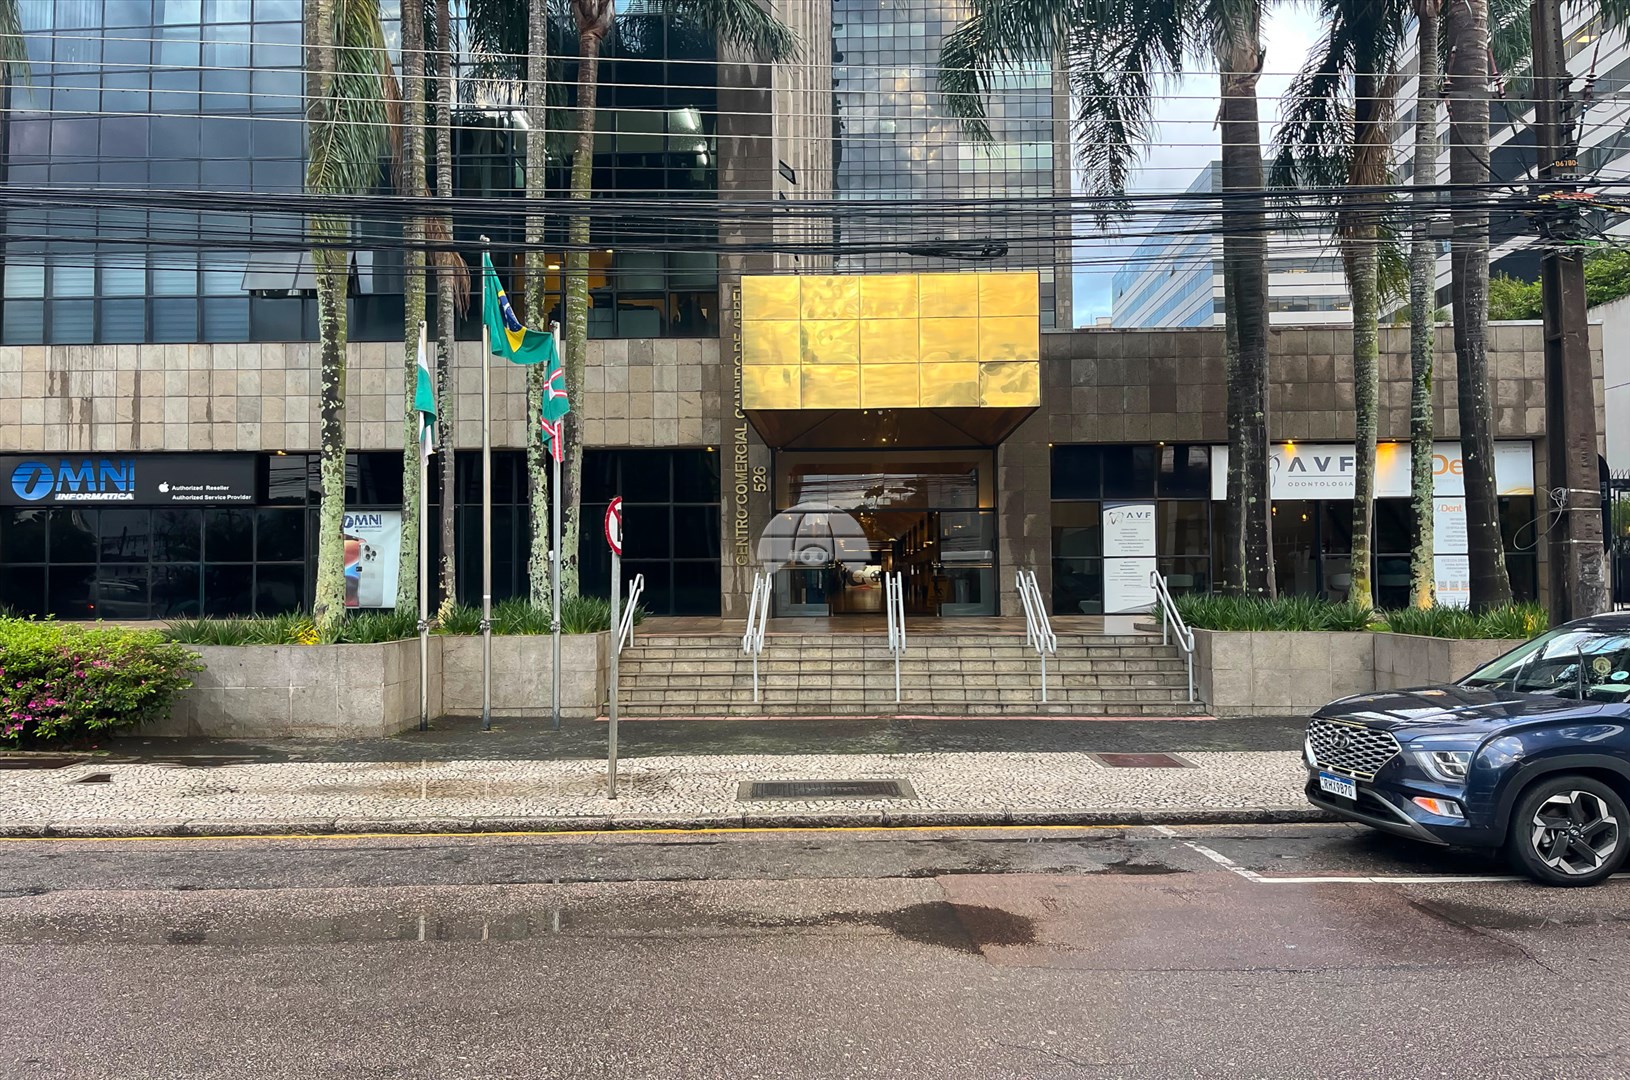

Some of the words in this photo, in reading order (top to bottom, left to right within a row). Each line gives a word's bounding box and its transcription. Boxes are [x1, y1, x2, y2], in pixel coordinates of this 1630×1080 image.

[734, 422, 748, 505] COMERCIAL
[1287, 456, 1355, 473] AVF
[11, 459, 135, 500] OMNI
[753, 465, 767, 493] 526
[56, 492, 134, 500] INFORMATICA
[1126, 511, 1151, 519] AVF
[735, 505, 748, 566] CENTRO
